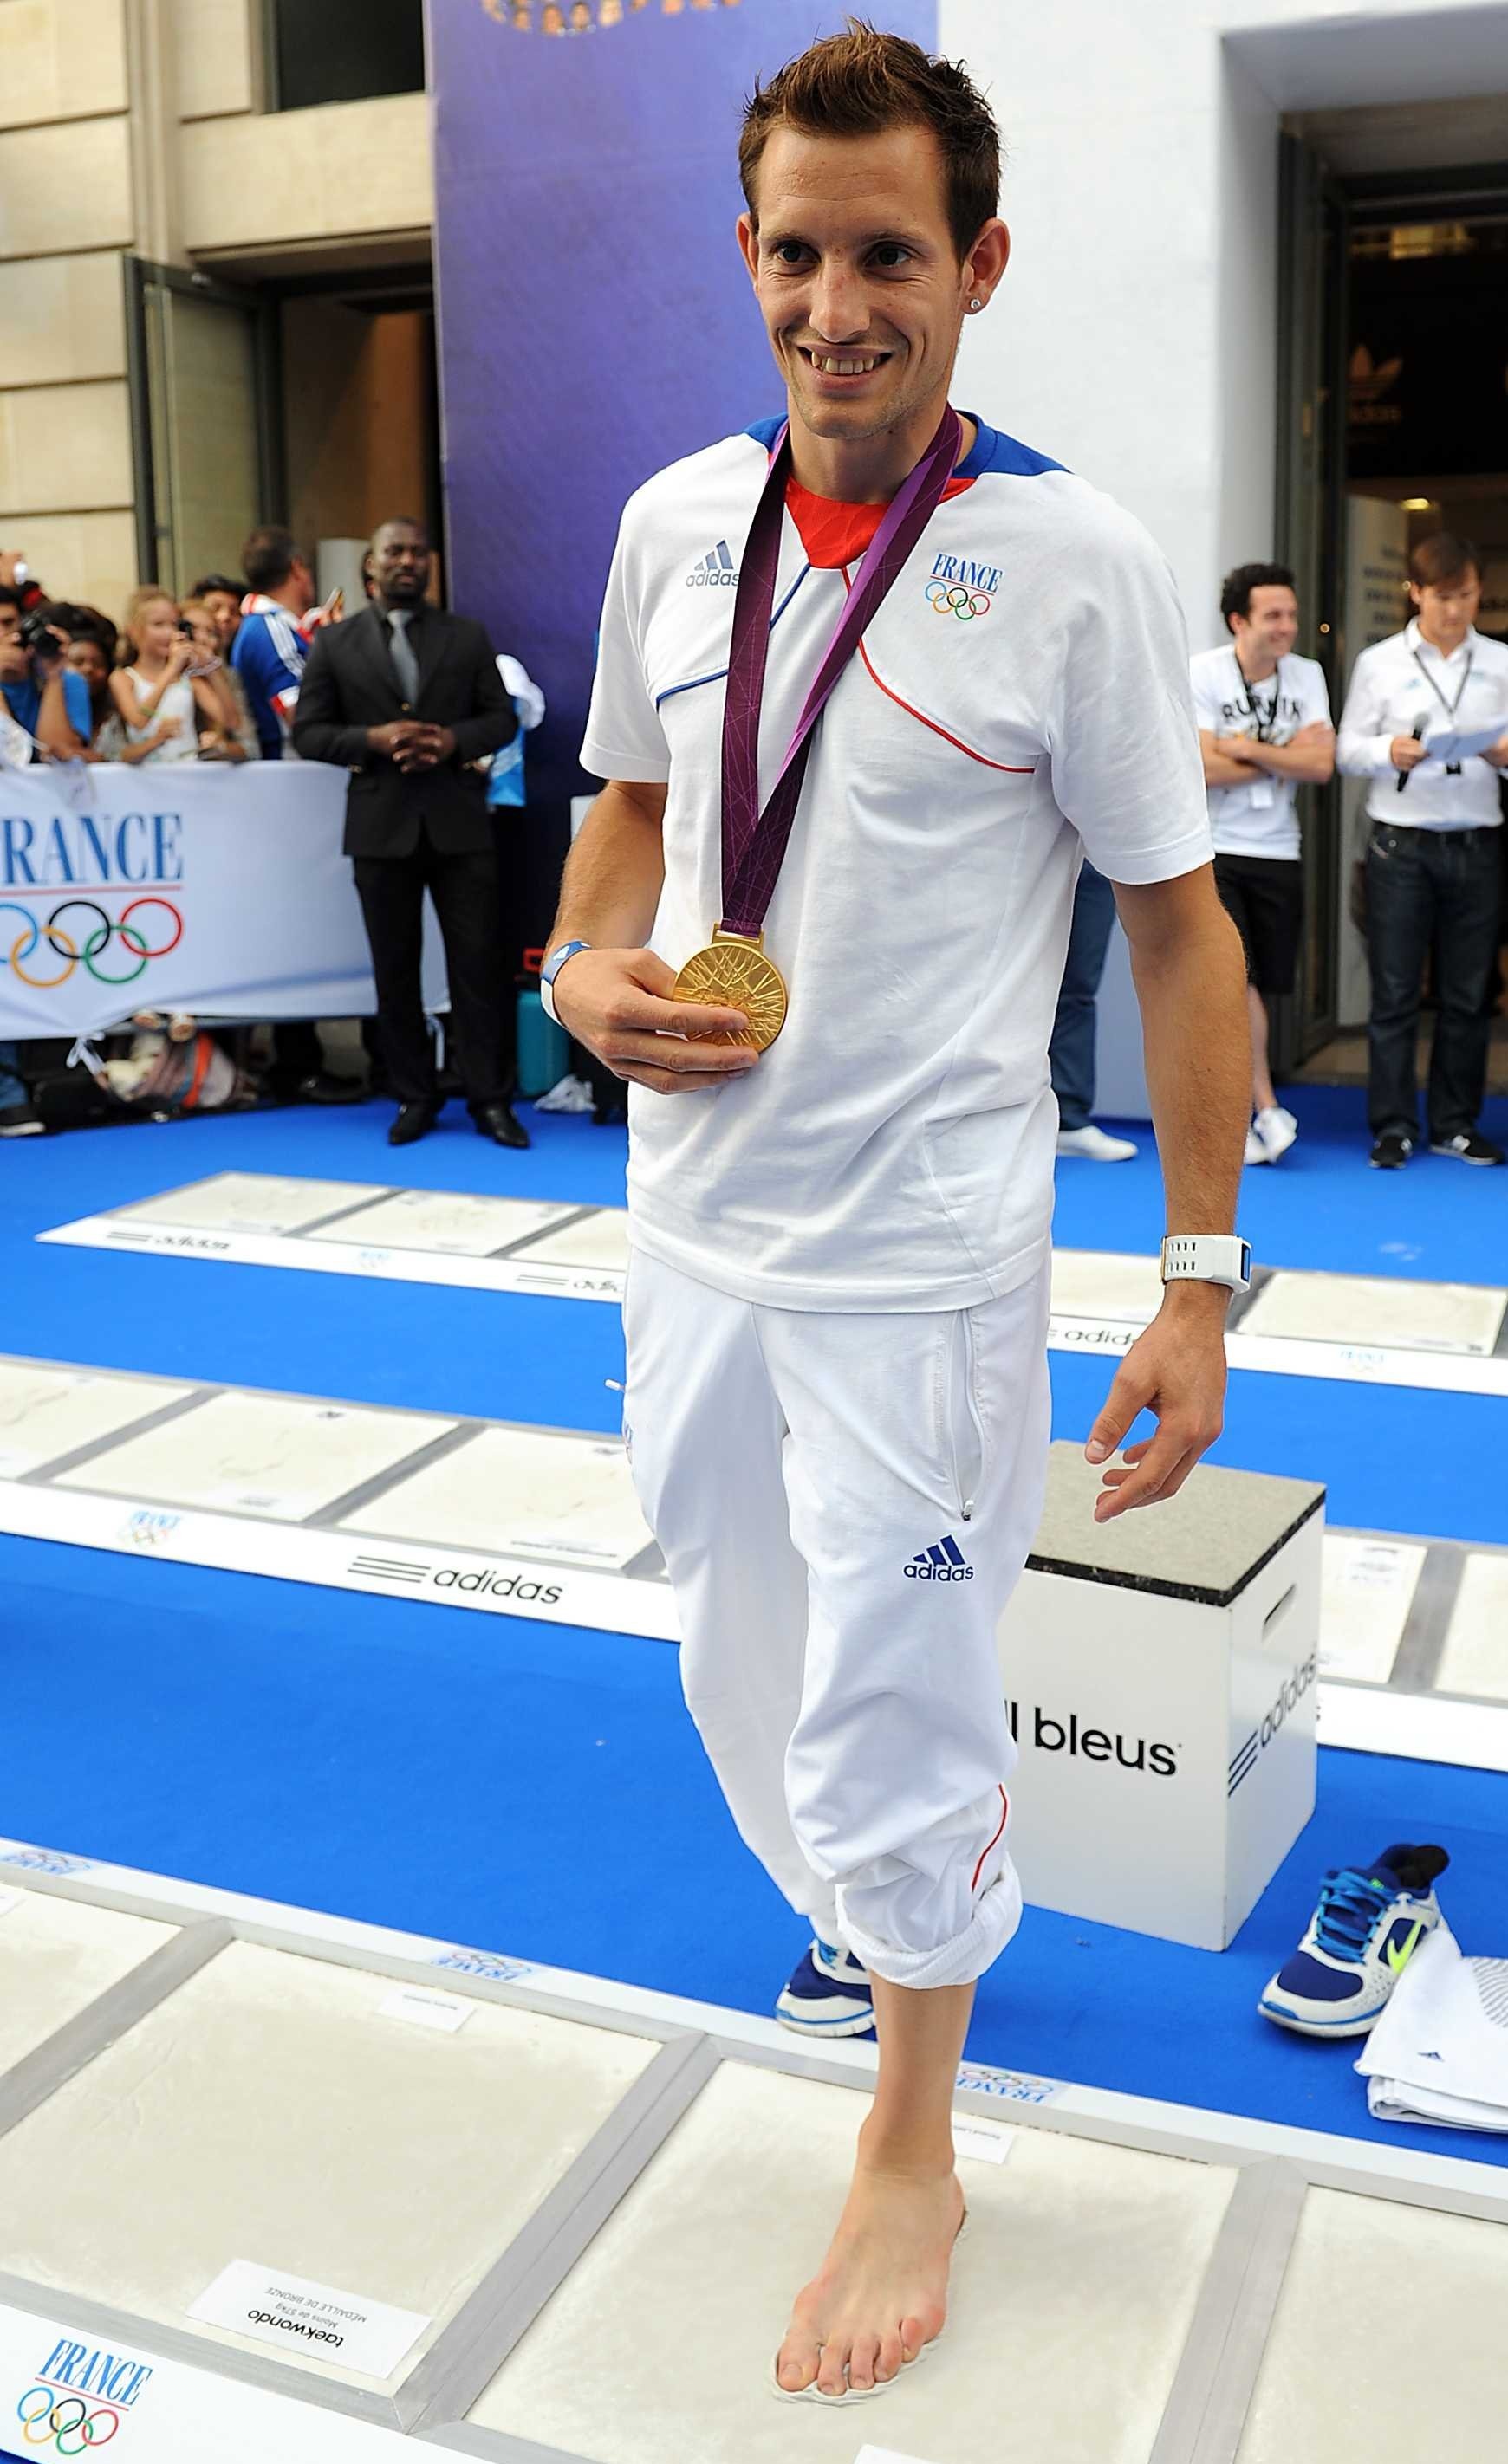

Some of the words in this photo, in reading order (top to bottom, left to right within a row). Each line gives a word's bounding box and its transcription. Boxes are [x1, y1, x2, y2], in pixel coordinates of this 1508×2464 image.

[686, 568, 741, 587] adidas
[931, 553, 1004, 593] FRANCE
[2, 813, 184, 884] RANCE
[1064, 1329, 1135, 1346] adid
[433, 1567, 563, 1605] adidas
[903, 1563, 974, 1582] adidas
[1261, 1652, 1316, 1747] adidas
[1034, 1706, 1177, 1777] bleus
[263, 2286, 305, 2305] BRONZE
[303, 2298, 320, 2309] DE
[247, 2309, 345, 2348] taekwondo
[38, 2338, 153, 2406] FRANCE
